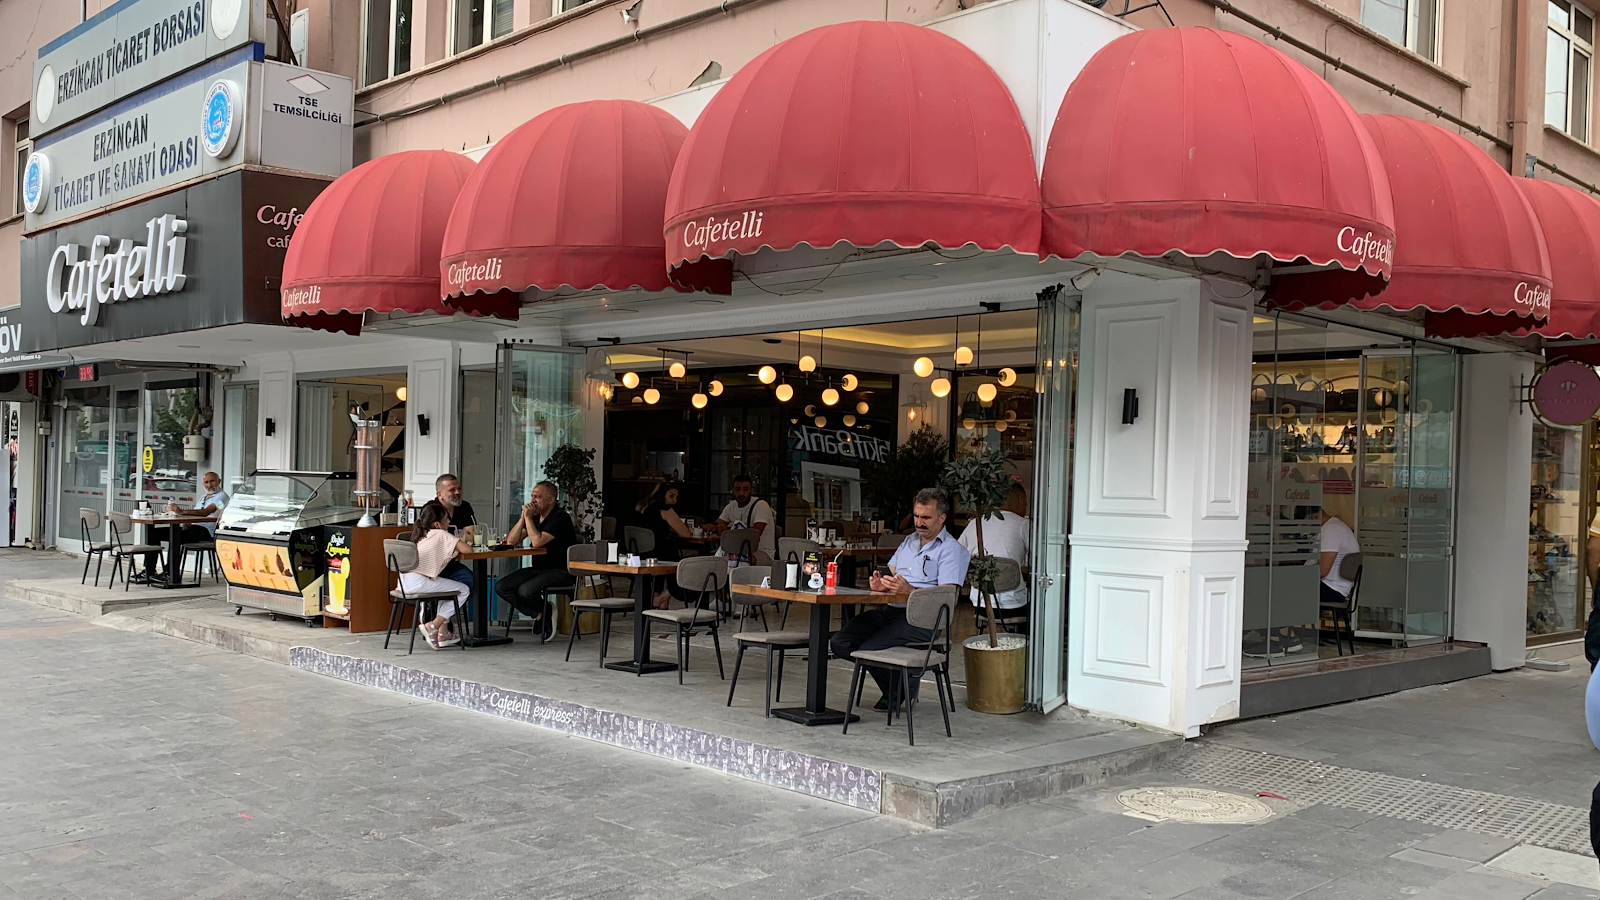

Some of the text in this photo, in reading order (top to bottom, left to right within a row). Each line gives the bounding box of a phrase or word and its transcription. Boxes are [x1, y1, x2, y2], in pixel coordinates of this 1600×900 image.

[57, 0, 205, 104] ERZİNCAN TİCARET BORSASI
[273, 102, 342, 124] TEMSİLCİLİĞİ
[298, 95, 319, 108] TSE
[93, 113, 149, 162] ERZİNCAN
[54, 172, 96, 211] TİCARET
[98, 166, 111, 197] VE
[113, 141, 156, 192] SANAYİ
[159, 135, 198, 177] ODASI
[683, 210, 764, 251] Cafetelli
[1336, 226, 1392, 267] Cafetelli
[46, 213, 189, 326] Cafetelli
[448, 258, 502, 288] Cafetelli
[282, 285, 321, 309] Cafetelli
